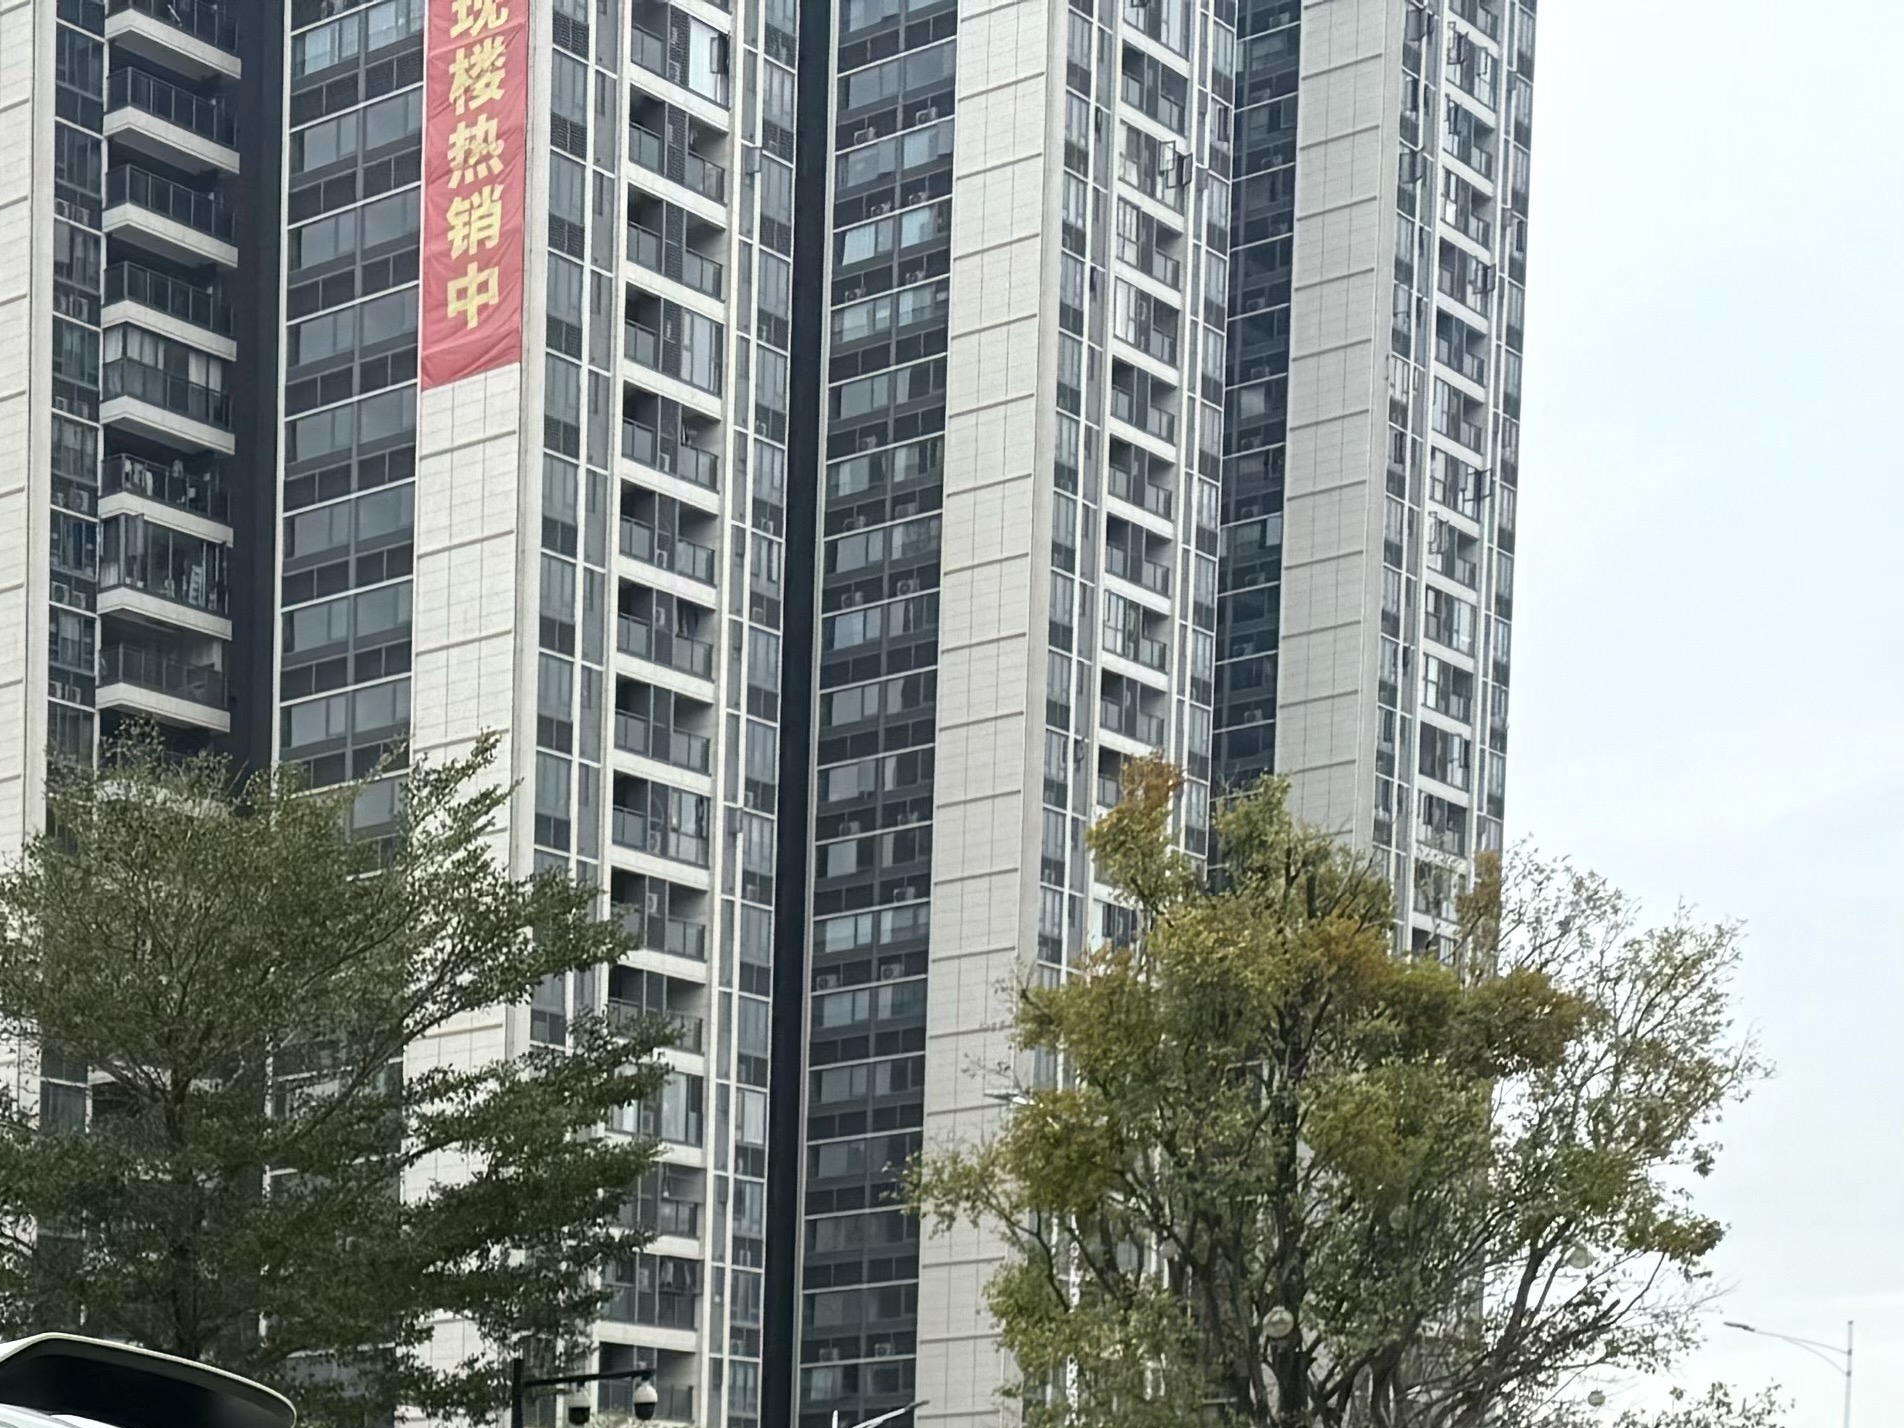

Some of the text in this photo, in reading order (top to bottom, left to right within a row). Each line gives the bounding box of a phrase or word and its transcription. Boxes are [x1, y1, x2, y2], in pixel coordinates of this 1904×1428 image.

[446, 0, 509, 330] 现楼热销中
